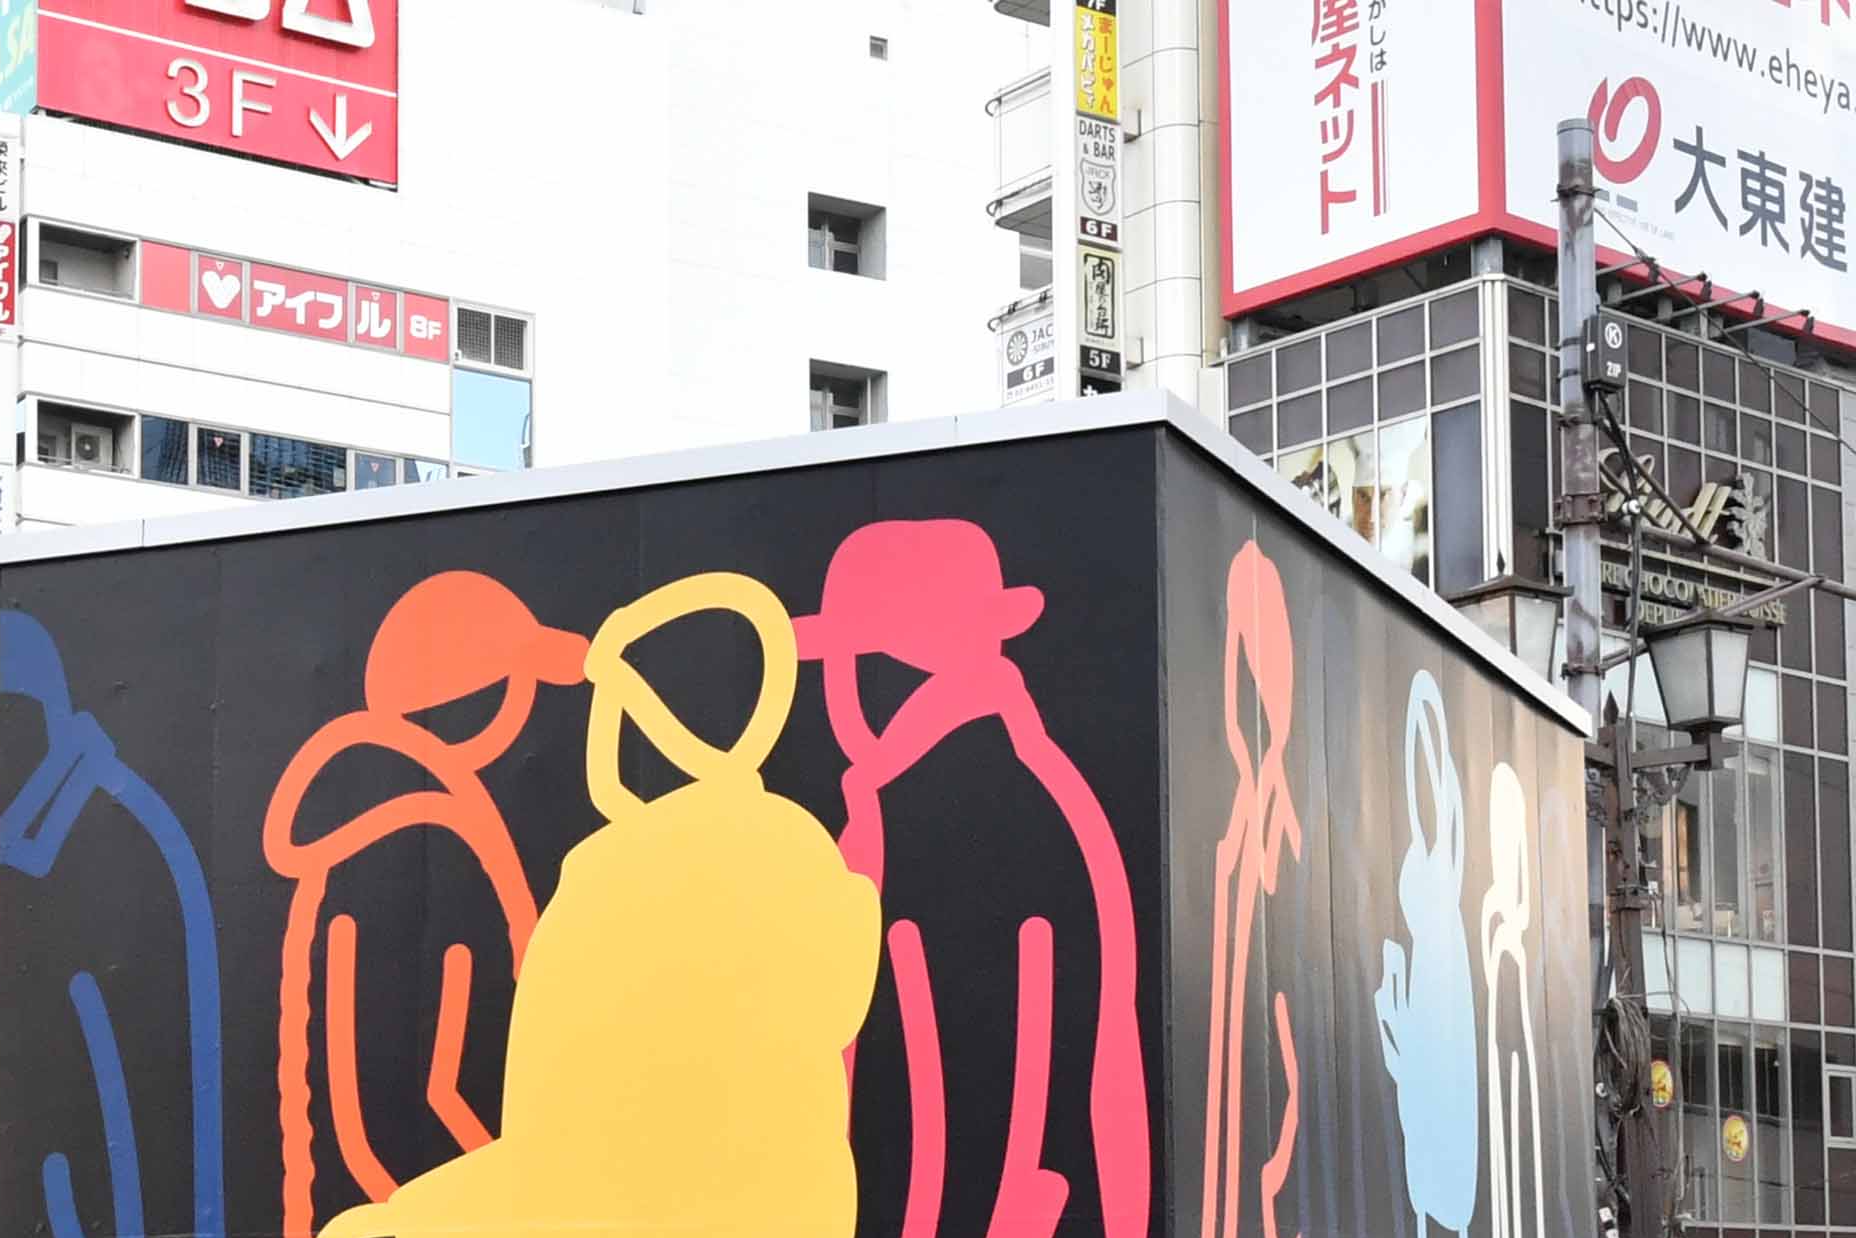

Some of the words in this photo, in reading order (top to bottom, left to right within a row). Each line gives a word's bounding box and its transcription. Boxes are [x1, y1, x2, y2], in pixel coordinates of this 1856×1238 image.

[165, 57, 277, 138] 3F
[1079, 119, 1116, 143] DARTS
[1093, 142, 1115, 161] BAR
[1672, 124, 1848, 274] 大東建
[1086, 220, 1112, 238] 6F
[253, 279, 392, 339] アイフル
[410, 314, 442, 340] 8F
[1031, 322, 1054, 344] JAC
[1089, 349, 1111, 369] 5F
[1024, 362, 1046, 381] 6F
